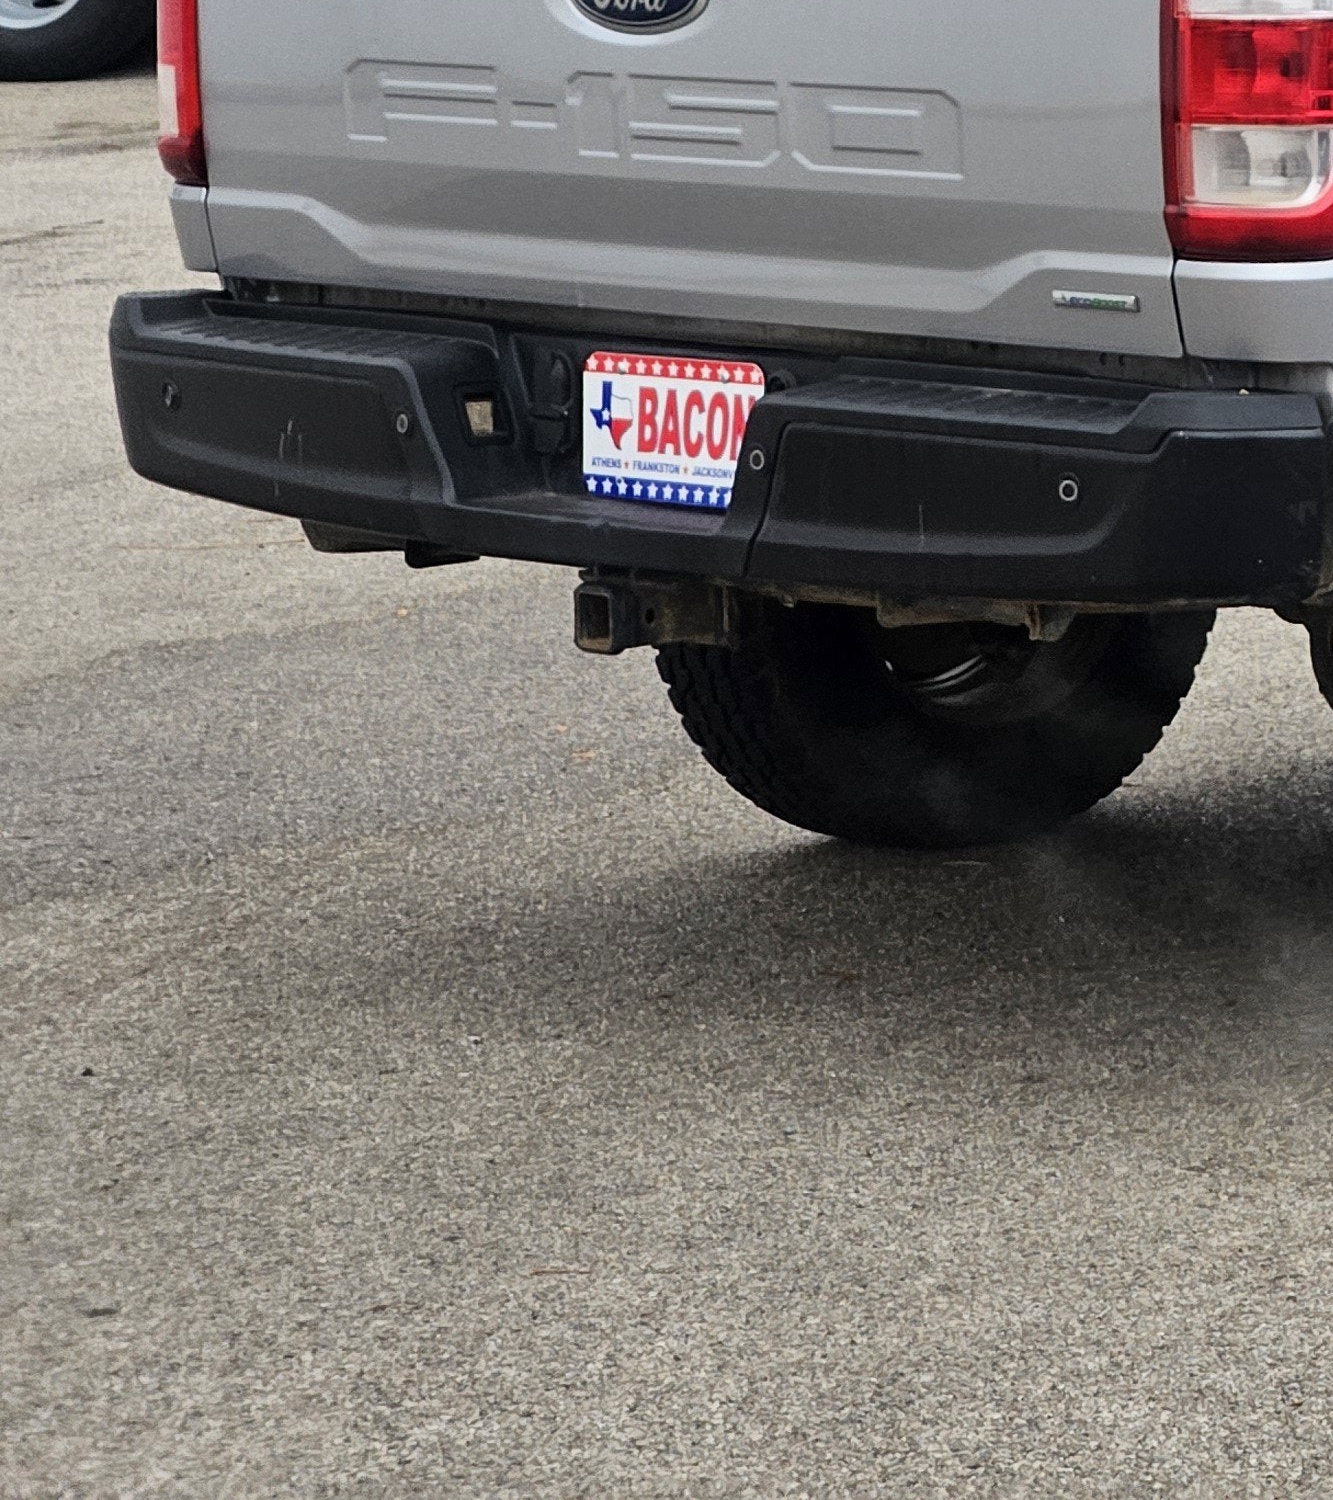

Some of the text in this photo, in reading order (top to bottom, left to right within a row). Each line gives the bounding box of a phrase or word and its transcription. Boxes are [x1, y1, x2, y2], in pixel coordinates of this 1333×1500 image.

[344, 57, 965, 181] F-150
[591, 455, 732, 479] ATHENS FRANKSTON JACKSONV
